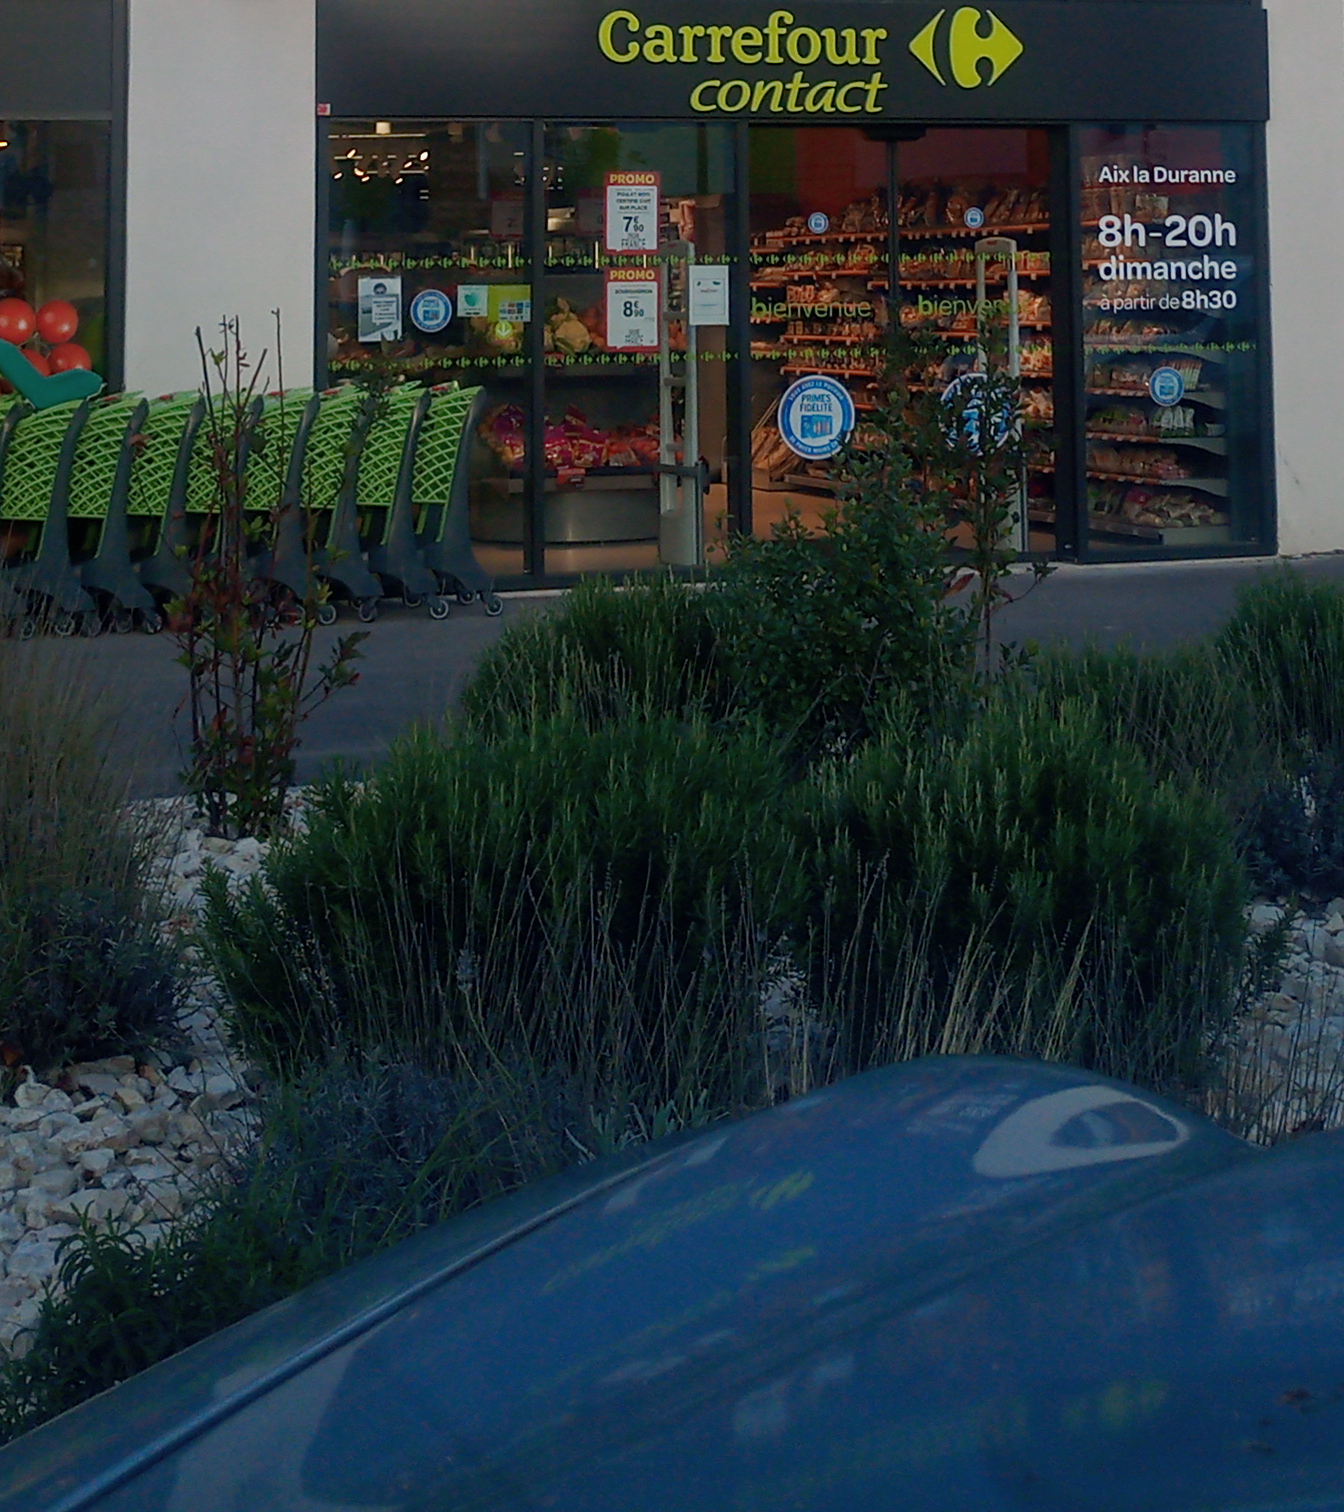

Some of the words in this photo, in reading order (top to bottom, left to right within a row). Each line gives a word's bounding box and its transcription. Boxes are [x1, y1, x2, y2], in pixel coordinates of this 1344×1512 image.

[599, 9, 887, 65] Carrefour
[690, 71, 888, 113] contact
[609, 174, 655, 184] PROMO
[1099, 165, 1130, 183] Aix
[1133, 165, 1150, 183] la
[1154, 166, 1236, 183] Duranne
[610, 270, 655, 280] PROMO
[1099, 254, 1237, 281] dimanche
[750, 297, 873, 318] bienvenue
[1100, 293, 1110, 310] à
[1113, 293, 1156, 314] partir
[1158, 292, 1180, 310] de
[1181, 289, 1237, 309] 8h30
